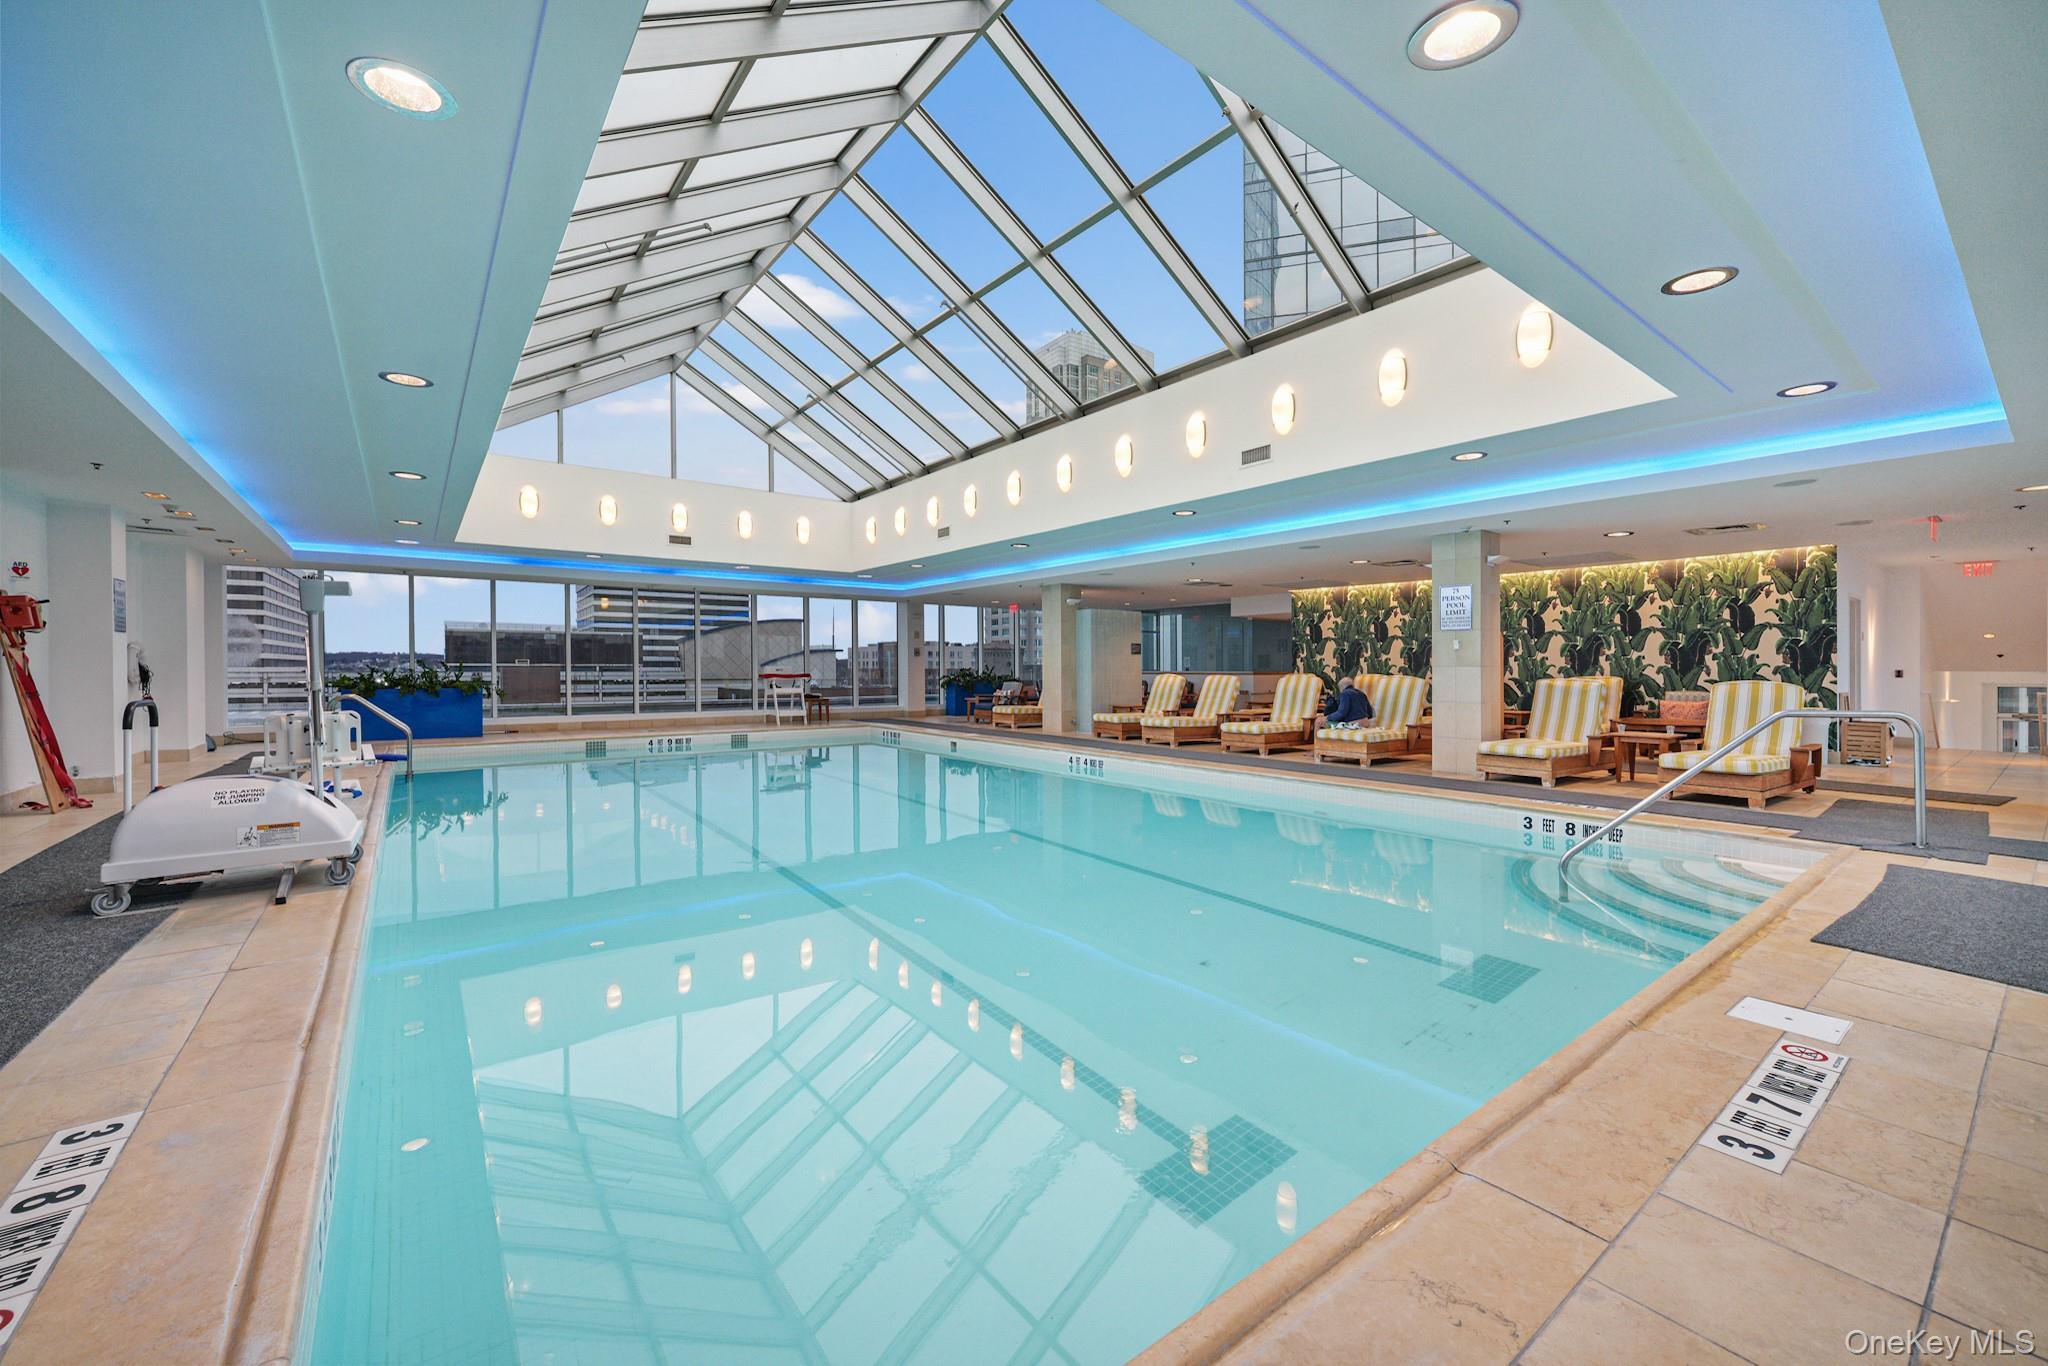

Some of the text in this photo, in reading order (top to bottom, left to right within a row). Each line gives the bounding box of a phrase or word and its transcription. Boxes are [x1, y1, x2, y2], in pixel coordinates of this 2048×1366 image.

[1963, 563, 1993, 576] EXIT
[218, 797, 260, 805] ALLOWED
[1523, 816, 1533, 830] 3
[1542, 818, 1555, 833] FEET
[1565, 822, 1576, 836] 8
[1746, 1092, 1803, 1117] 7
[60, 1122, 124, 1145] 3
[1717, 1134, 1776, 1160] 3
[32, 1147, 112, 1180] FEET
[10, 1183, 87, 1214] 8
